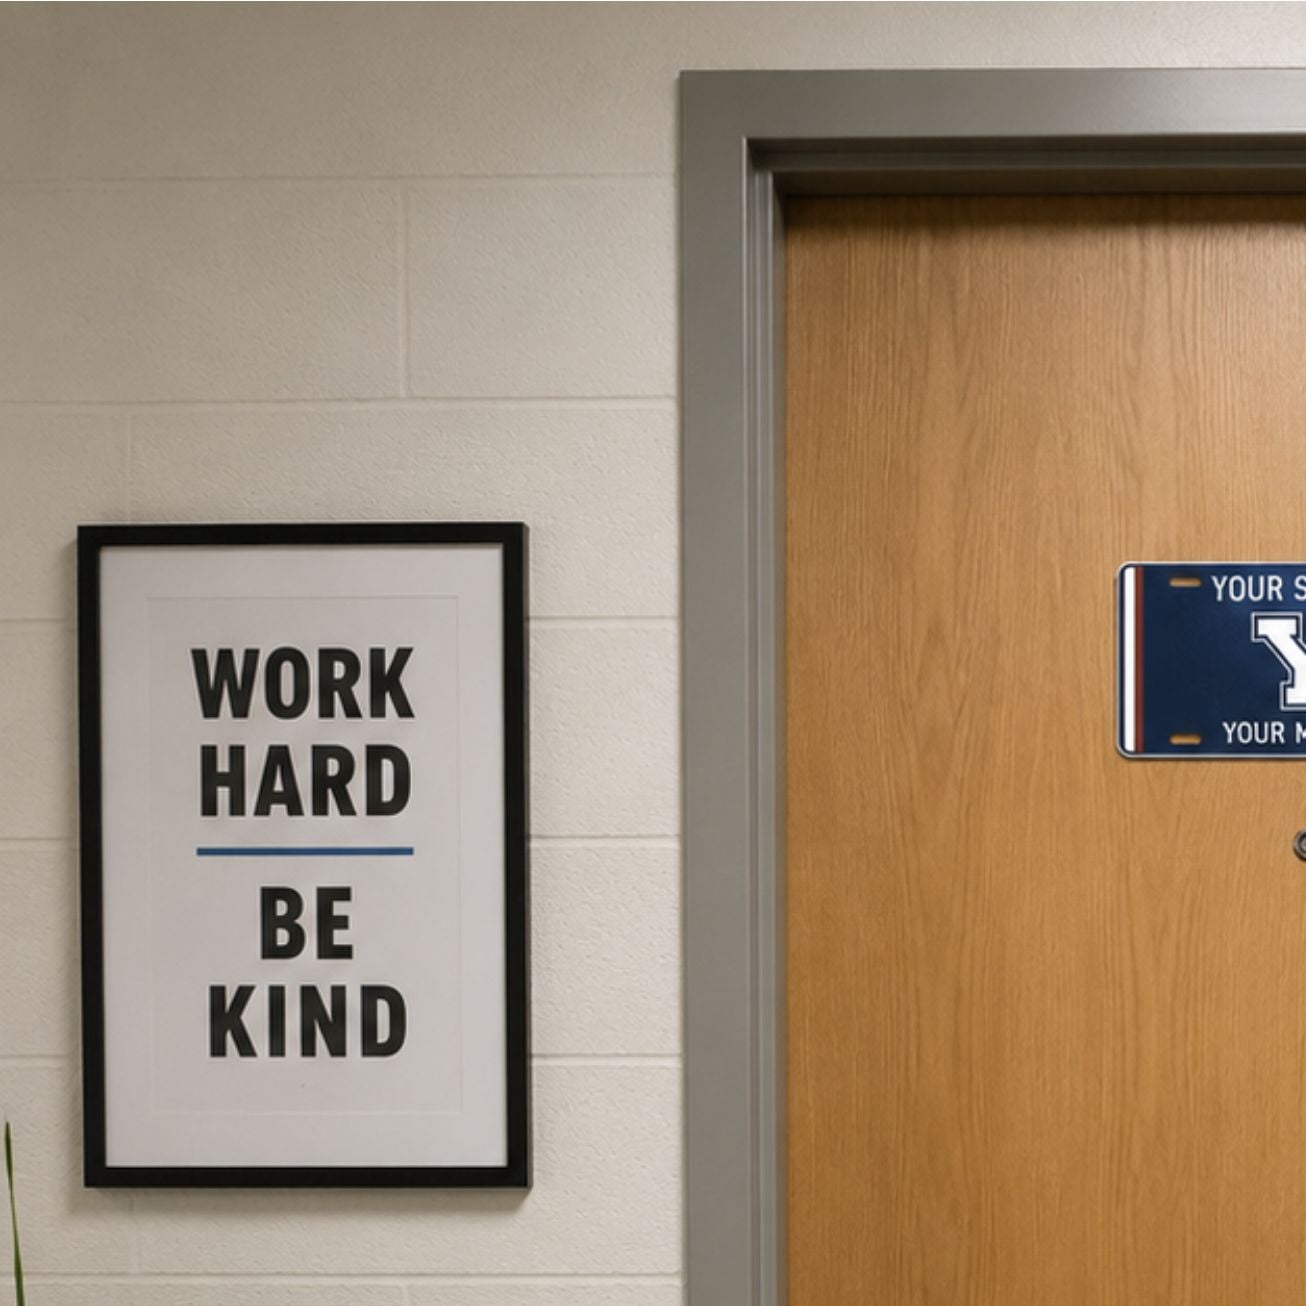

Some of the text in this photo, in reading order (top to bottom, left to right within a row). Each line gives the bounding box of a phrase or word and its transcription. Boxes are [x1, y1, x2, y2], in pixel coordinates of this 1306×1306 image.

[1211, 574, 1283, 602] YOUR
[191, 646, 415, 720] WORK
[1222, 721, 1285, 744] YOUR
[200, 744, 411, 817] HARD
[260, 886, 353, 960] BE
[209, 984, 407, 1058] KIND
